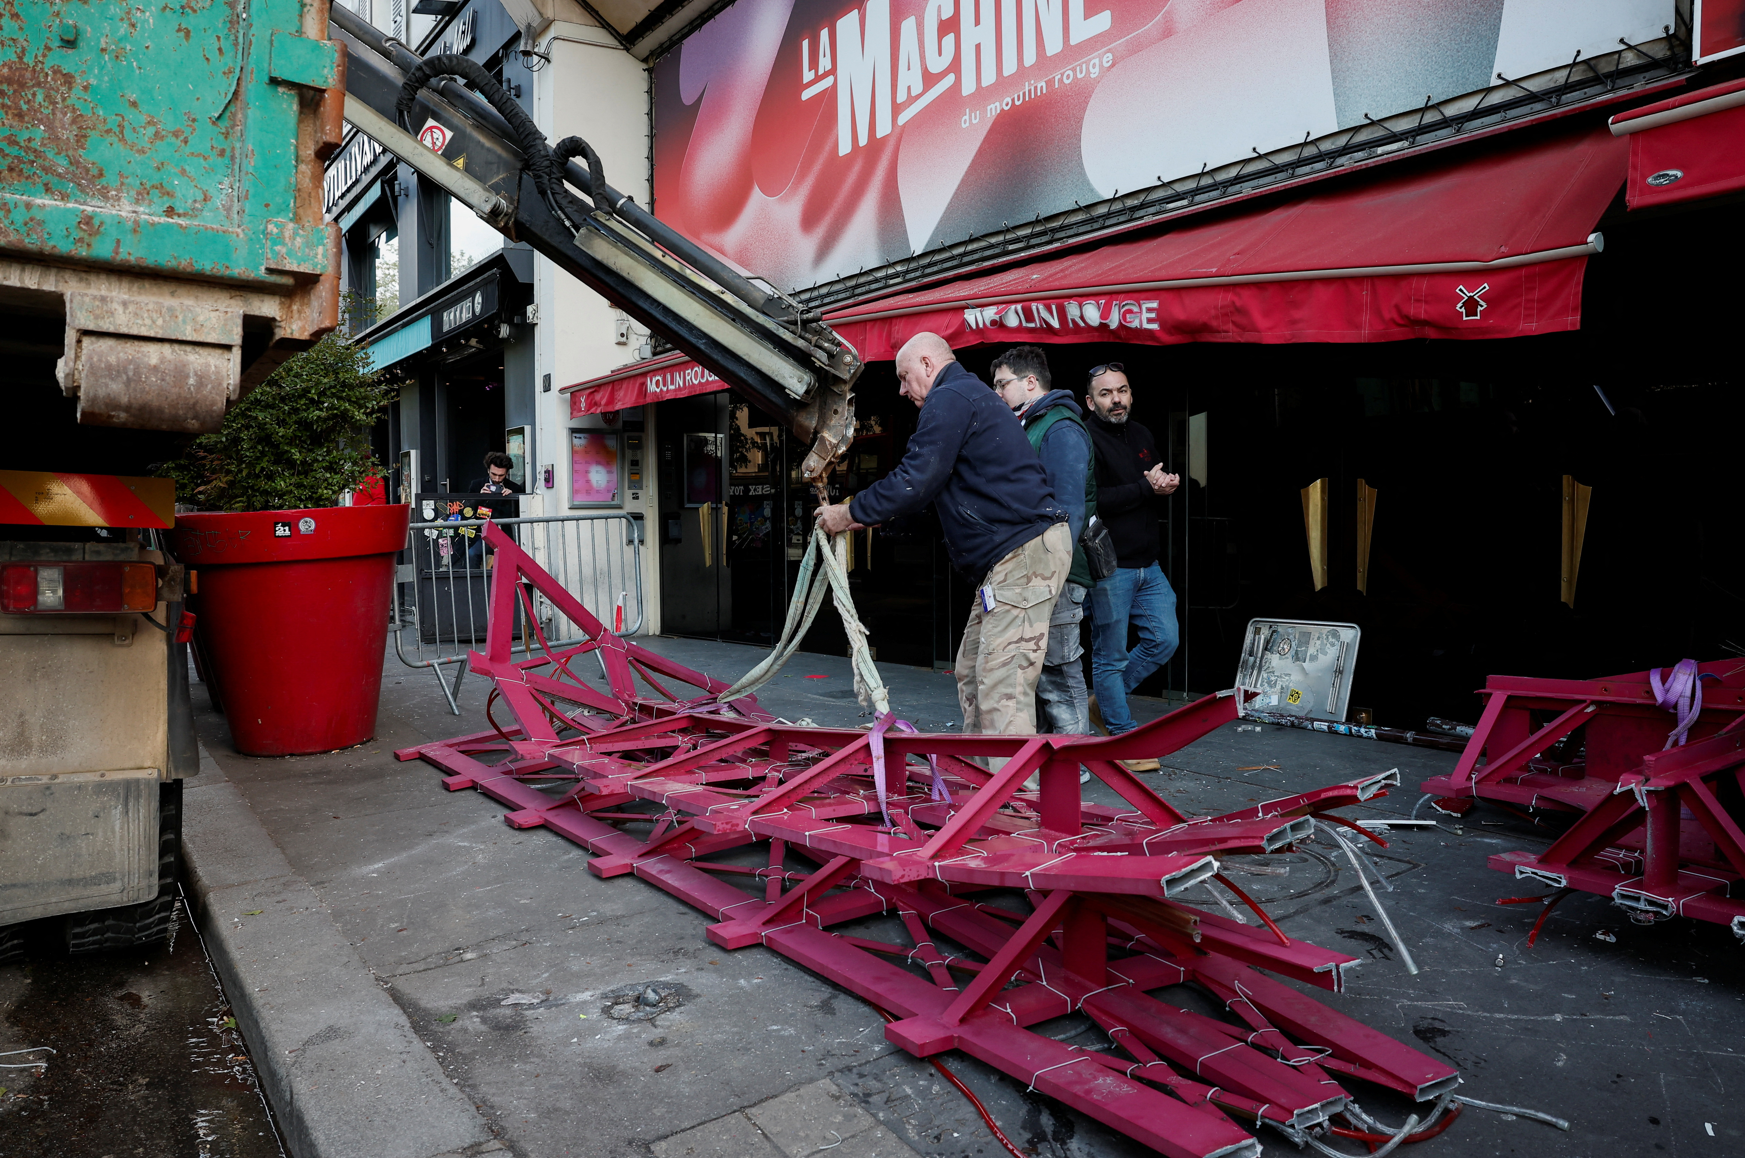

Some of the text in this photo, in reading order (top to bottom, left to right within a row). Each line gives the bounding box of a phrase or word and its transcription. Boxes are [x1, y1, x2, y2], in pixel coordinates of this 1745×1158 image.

[802, 26, 832, 84] LA
[961, 52, 1114, 129] du moulin rouge
[963, 299, 1160, 331] MOULIN ROUGE
[647, 371, 684, 393] MOULIN
